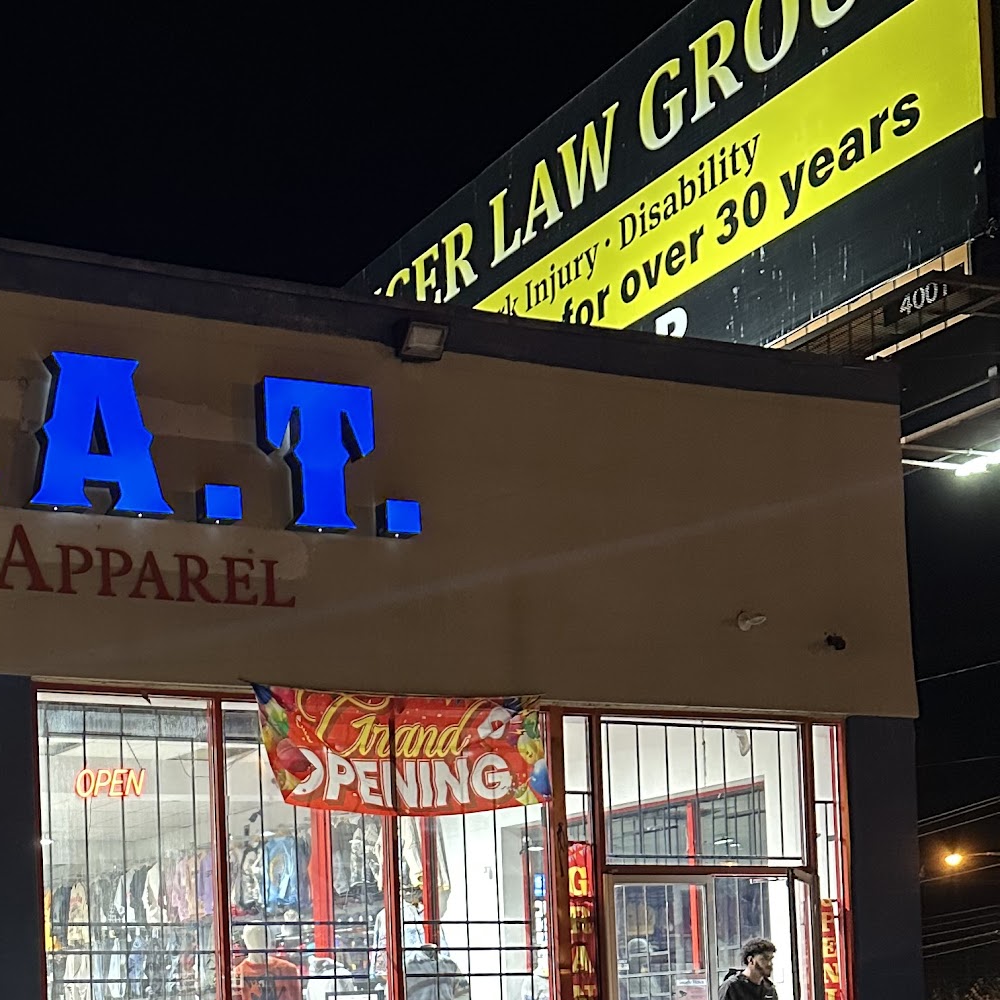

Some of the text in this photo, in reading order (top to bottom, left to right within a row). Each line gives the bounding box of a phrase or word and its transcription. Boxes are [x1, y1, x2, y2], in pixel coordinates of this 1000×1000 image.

[489, 101, 619, 268] LAW
[525, 133, 761, 313] Injury Disability
[562, 284, 610, 327] for
[620, 224, 705, 304] over
[716, 181, 767, 245] 30
[779, 93, 921, 220] years
[75, 768, 146, 798] OPEN
[297, 690, 490, 758] Grand
